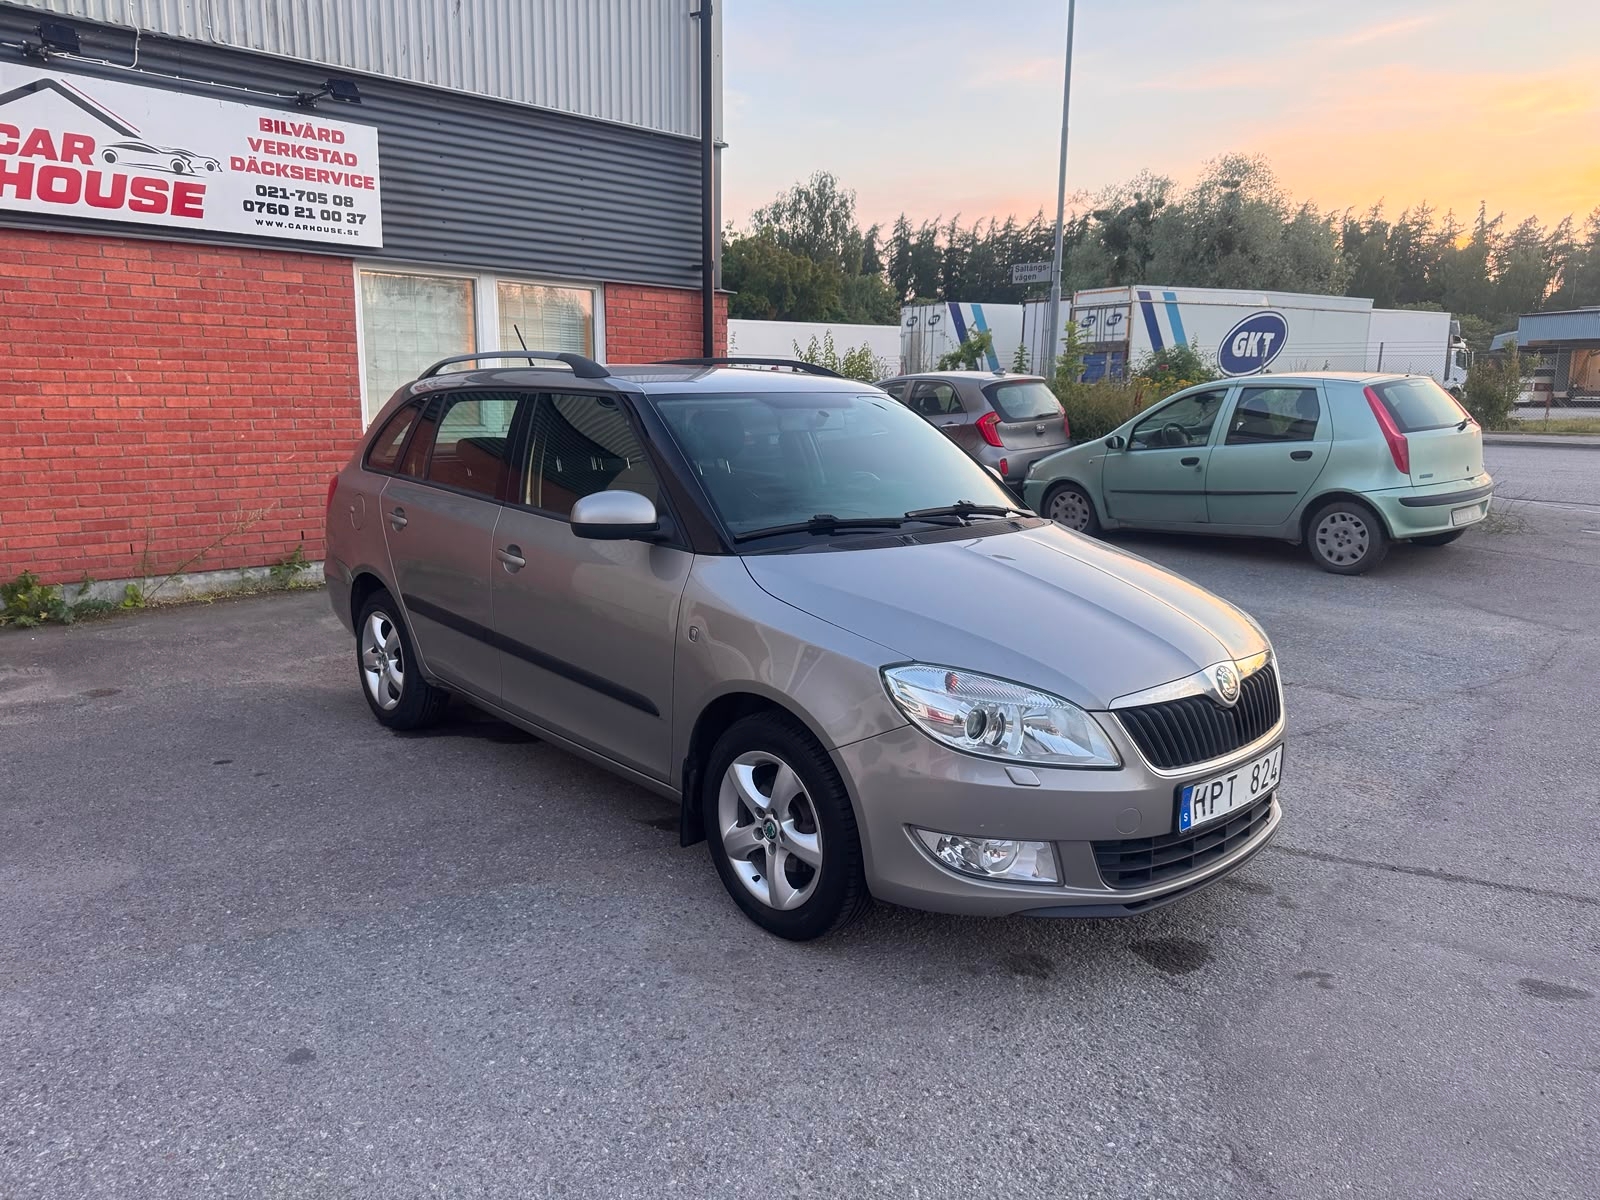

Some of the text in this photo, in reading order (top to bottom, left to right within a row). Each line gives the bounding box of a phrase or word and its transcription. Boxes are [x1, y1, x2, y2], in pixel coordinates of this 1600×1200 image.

[0, 123, 95, 165] CAR
[247, 137, 358, 166] VERKSTAD
[230, 156, 375, 190] DÄCKSERVICE
[0, 160, 206, 218] HOUSE
[255, 184, 354, 207] 021-705 08
[243, 199, 367, 225] 0760 21 00 37
[255, 219, 359, 236] WWW.CARHOUSE.SE
[1231, 331, 1275, 357] GKT
[1194, 752, 1278, 819] HPT 824
[1183, 813, 1189, 822] S
